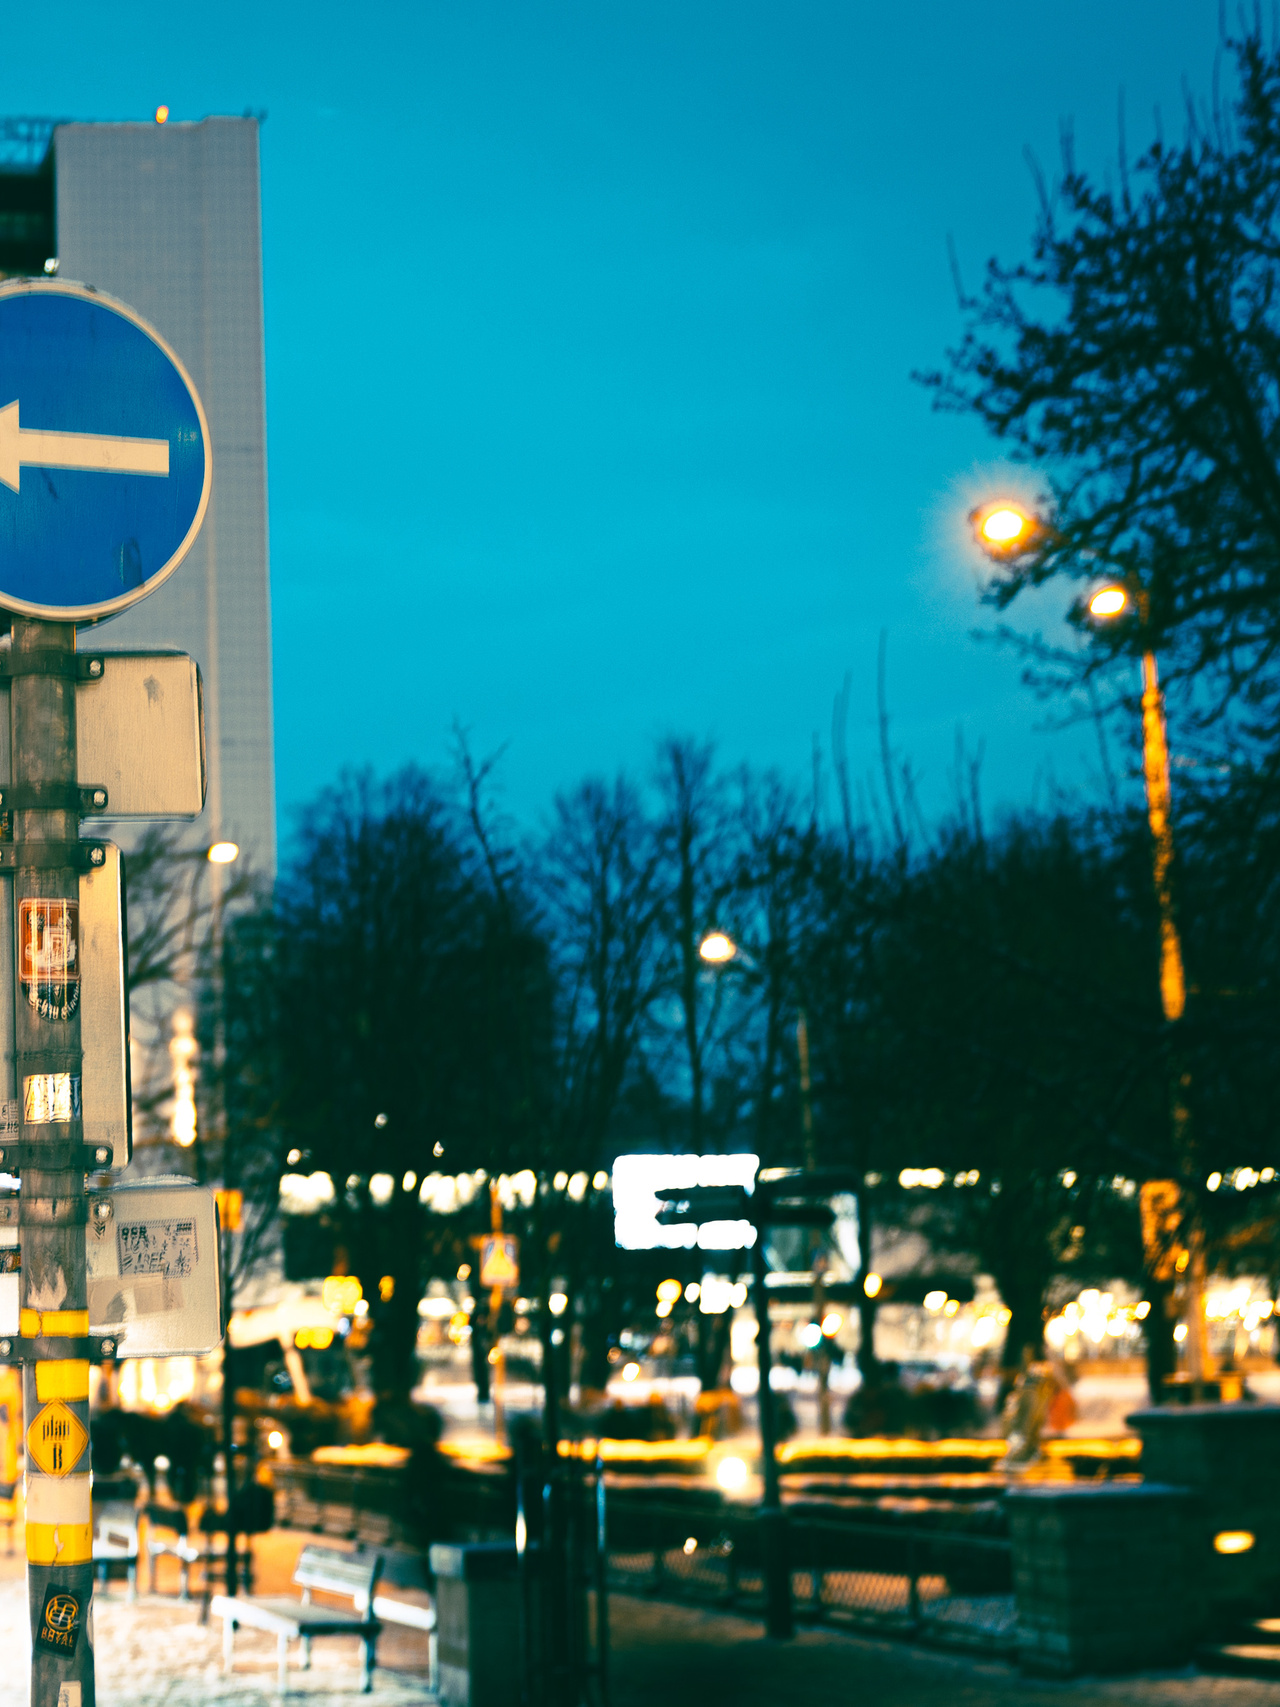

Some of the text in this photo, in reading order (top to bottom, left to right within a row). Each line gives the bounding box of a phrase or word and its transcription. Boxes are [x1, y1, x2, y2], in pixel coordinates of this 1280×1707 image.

[43, 1415, 70, 1444] plan
[53, 1445, 62, 1470] B
[41, 1626, 73, 1648] ROYAL
